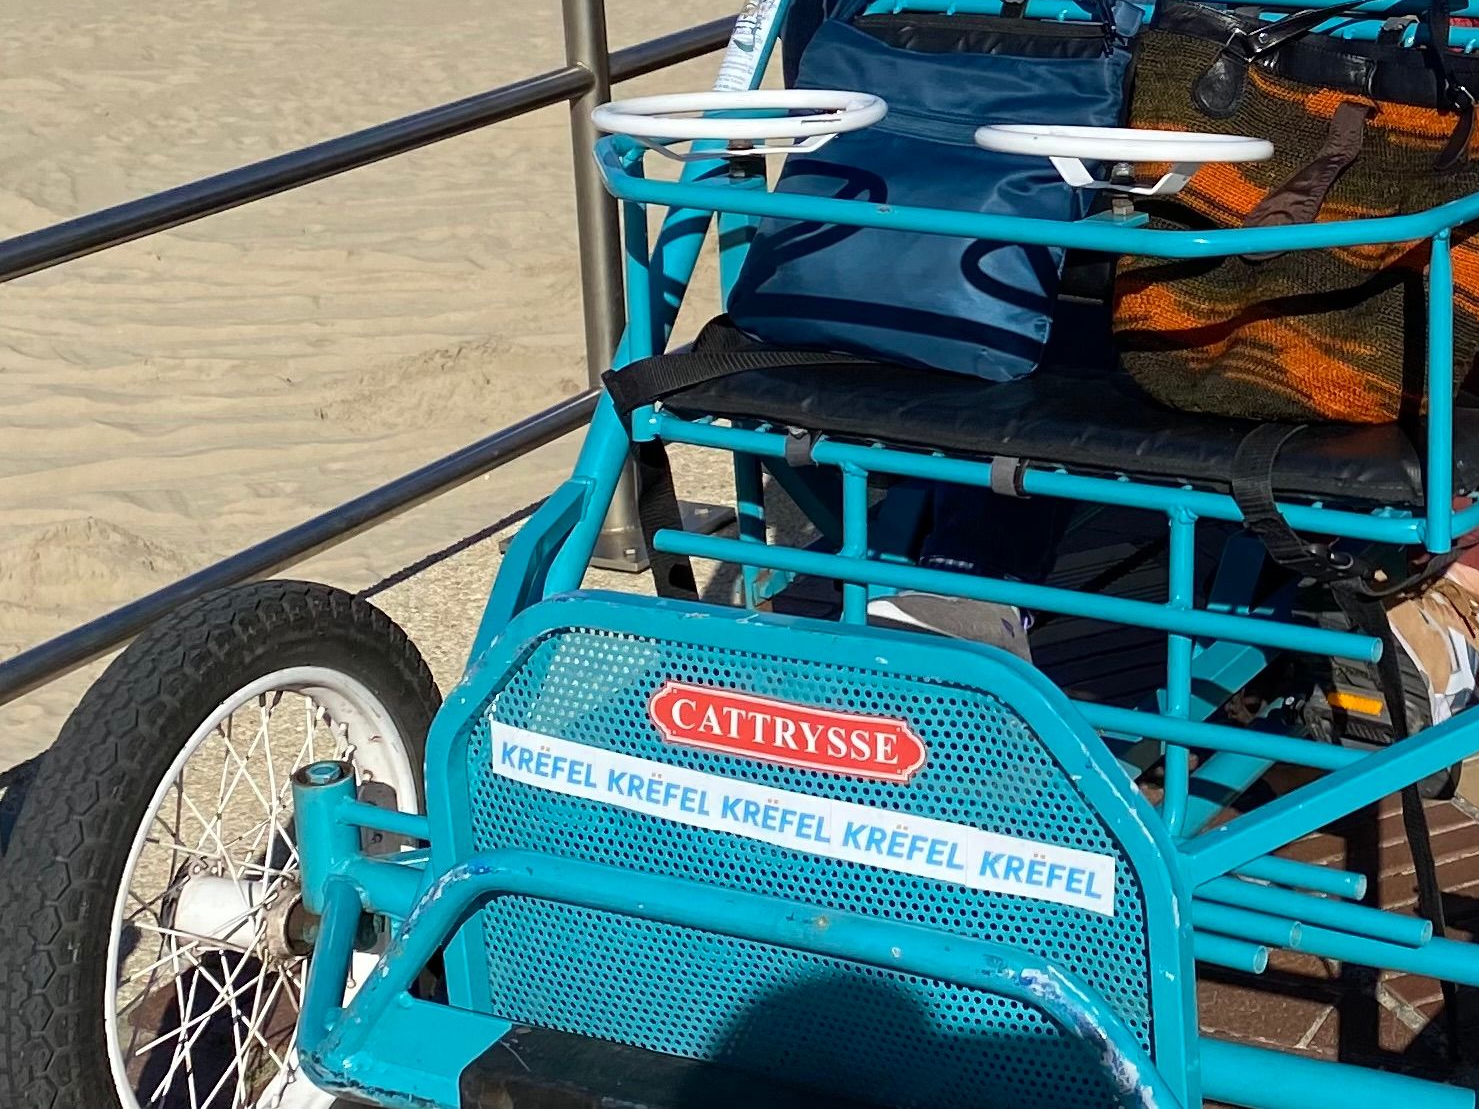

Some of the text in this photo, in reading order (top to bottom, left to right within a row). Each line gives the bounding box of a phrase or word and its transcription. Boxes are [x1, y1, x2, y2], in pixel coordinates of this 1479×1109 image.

[671, 698, 899, 765] CATTRYSSE
[500, 742, 1103, 900] KRËFEL KRËFEL KRËFEL KRËFEL KRËFEL
